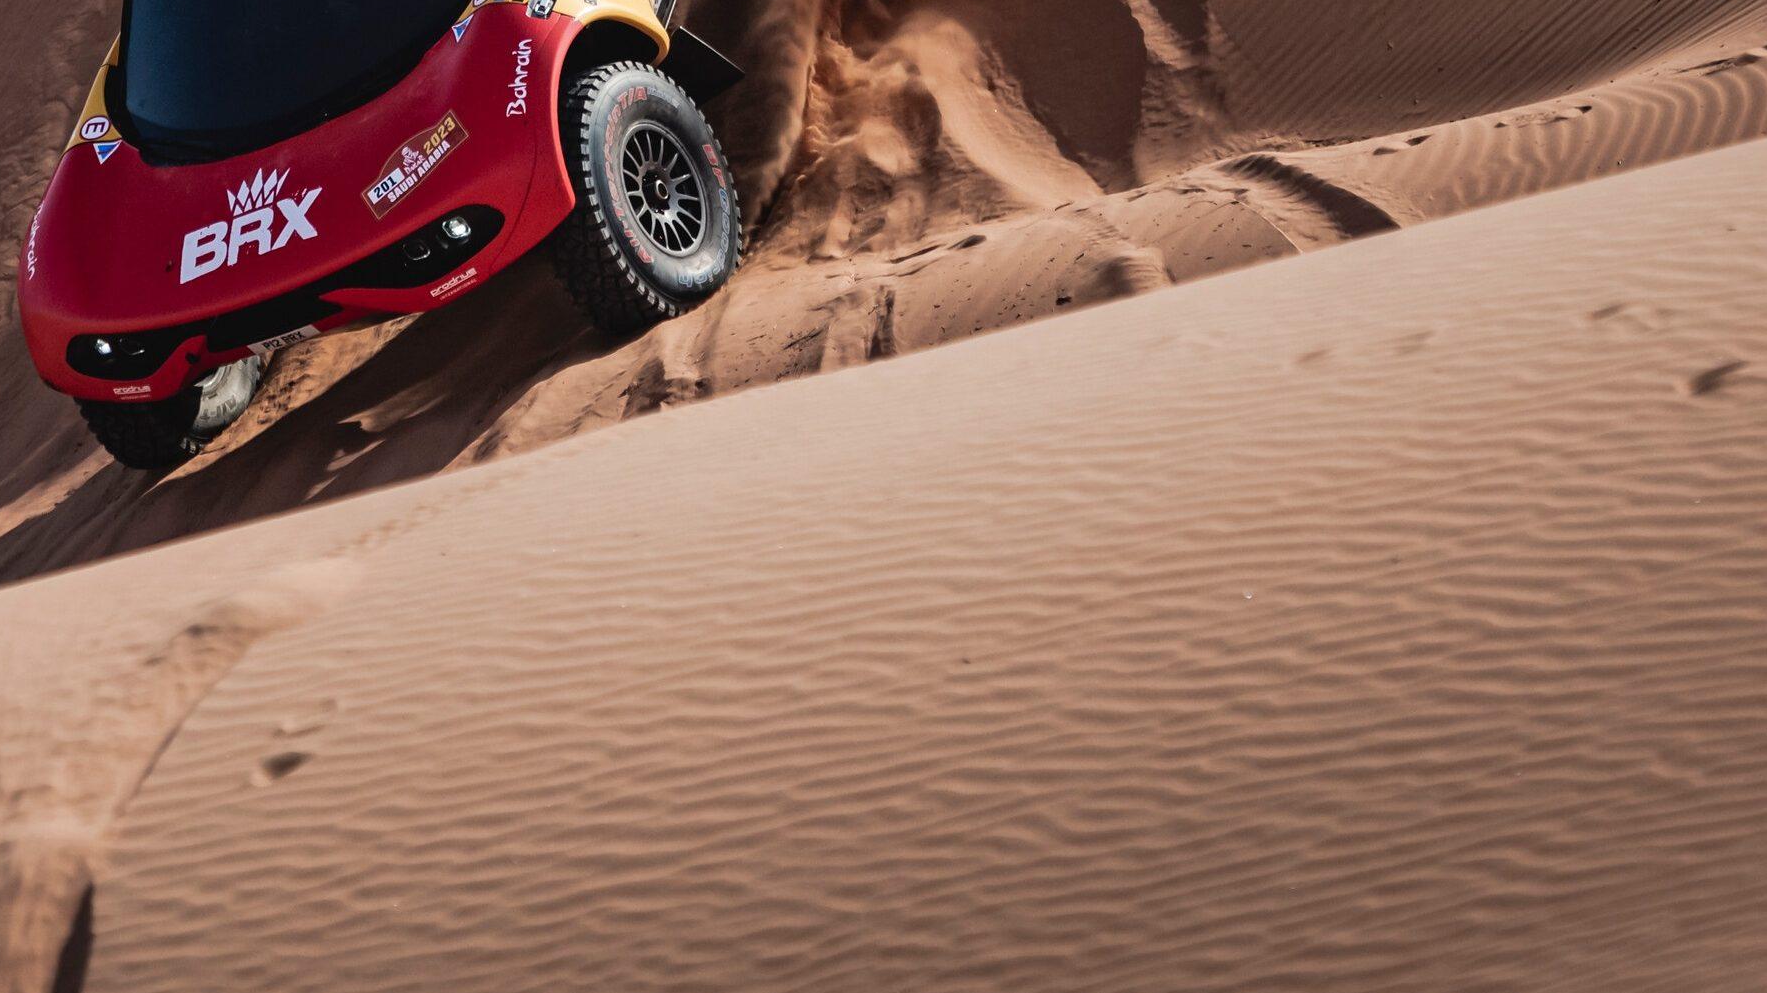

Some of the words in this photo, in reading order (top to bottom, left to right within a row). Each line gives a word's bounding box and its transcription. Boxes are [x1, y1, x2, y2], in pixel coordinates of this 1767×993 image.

[505, 38, 533, 118] Bahrain
[423, 116, 456, 155] 2023
[373, 176, 397, 199] 201
[386, 171, 420, 204] SAUDI
[417, 139, 451, 182] ARABIA
[179, 186, 324, 285] BRX
[429, 266, 478, 298] prodrive
[112, 385, 152, 395] prodrive
